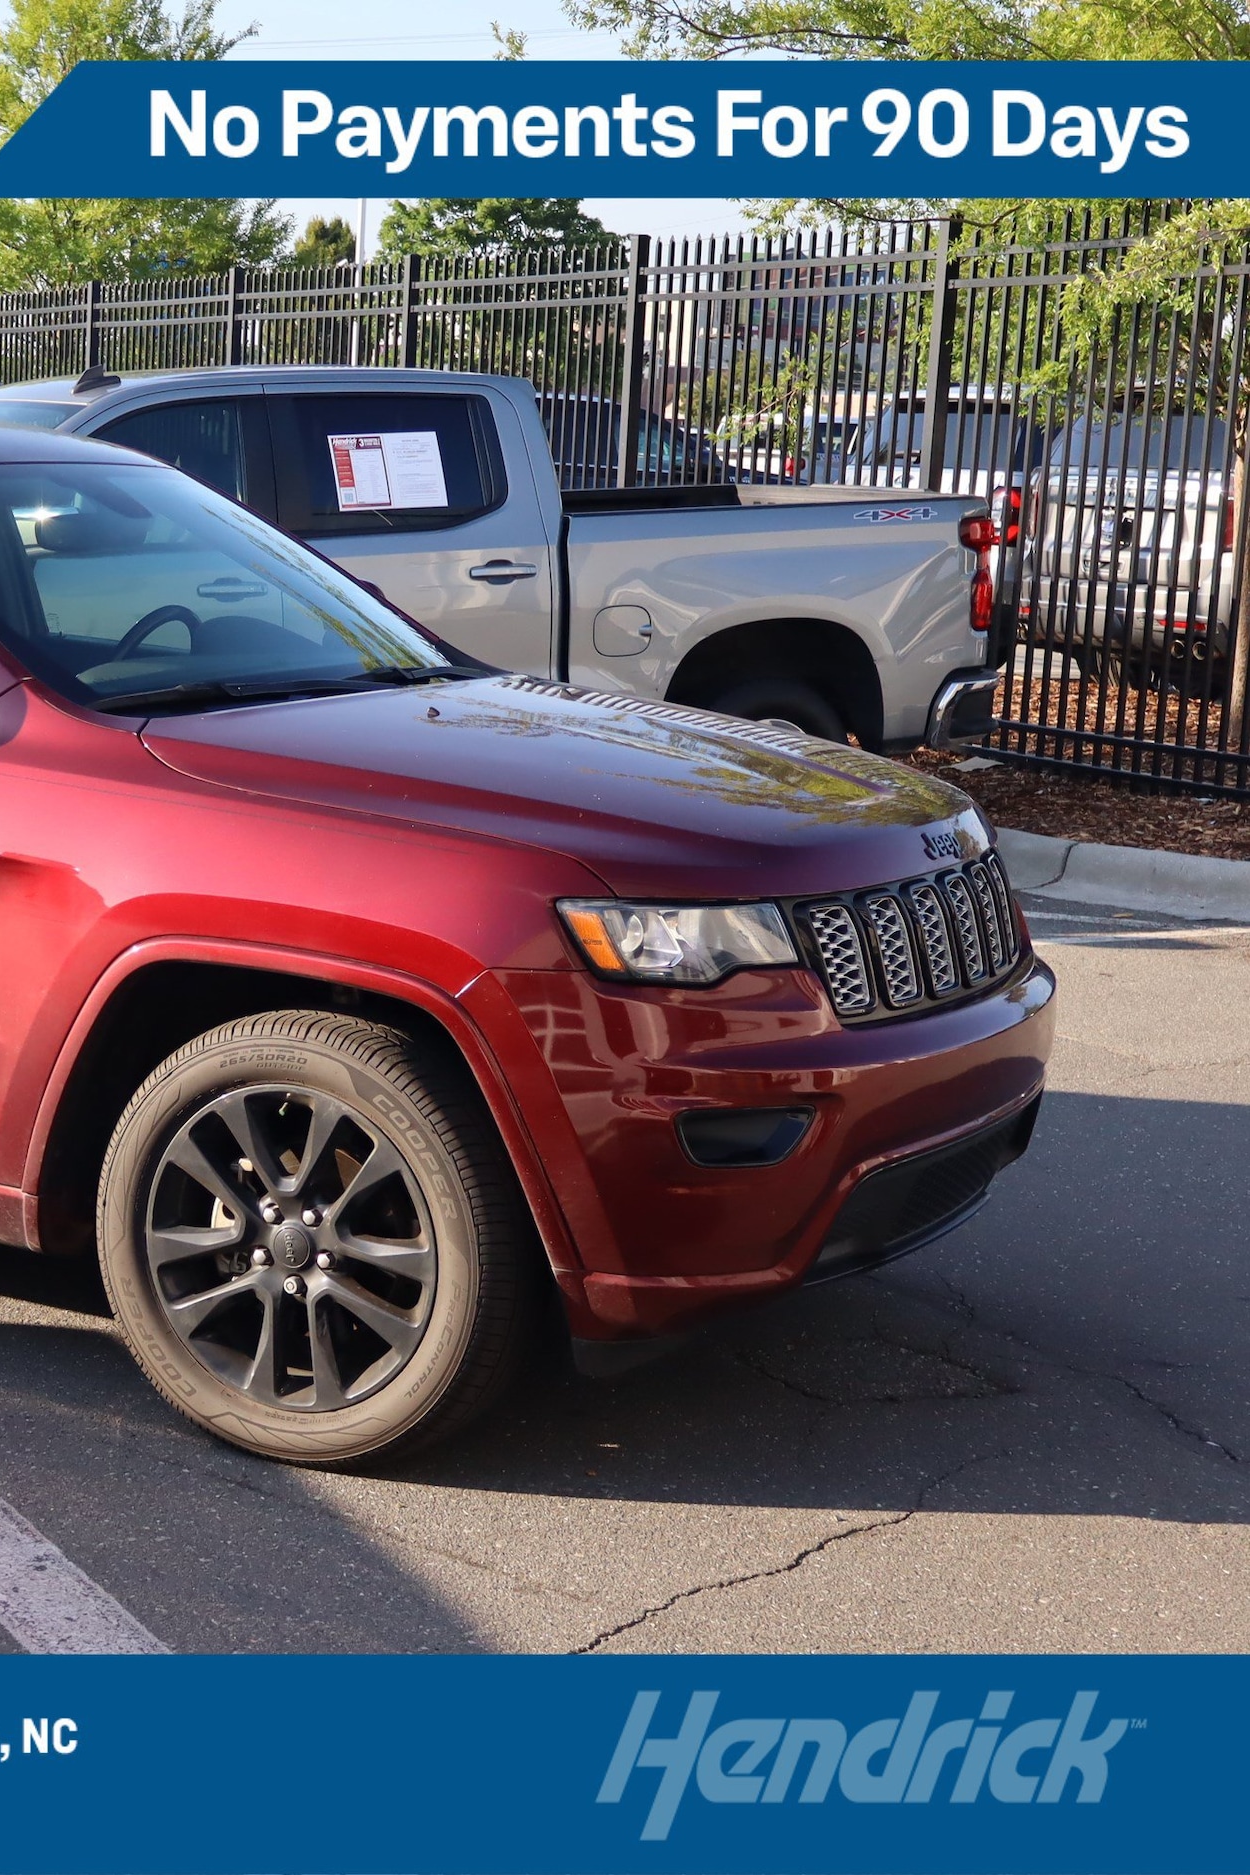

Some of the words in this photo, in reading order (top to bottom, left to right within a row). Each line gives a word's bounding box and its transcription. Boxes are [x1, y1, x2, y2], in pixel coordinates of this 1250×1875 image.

[920, 831, 962, 860] Jeep
[219, 1053, 308, 1068] 265/50R20
[372, 1094, 458, 1219] COOPER
[120, 1278, 197, 1397] COOPER
